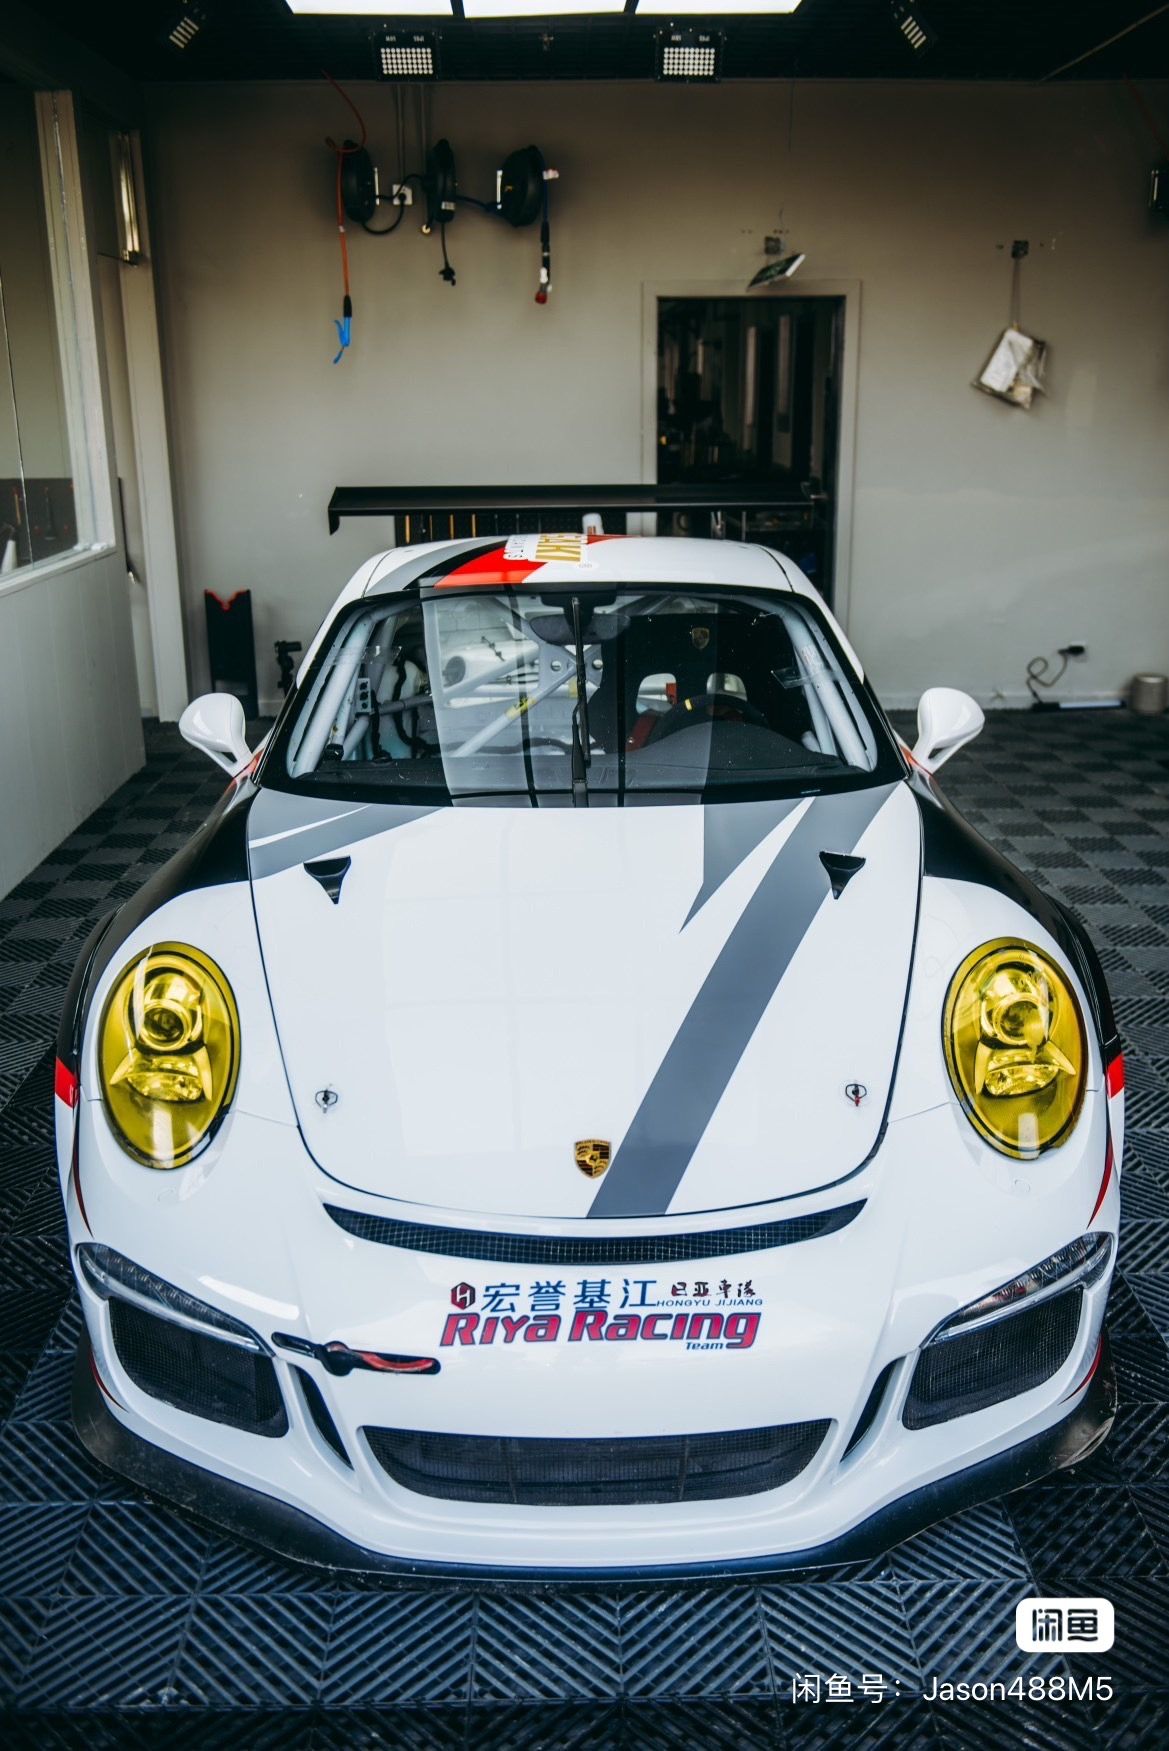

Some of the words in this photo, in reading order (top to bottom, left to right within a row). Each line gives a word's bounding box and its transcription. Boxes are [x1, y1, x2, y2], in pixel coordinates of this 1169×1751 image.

[481, 1278, 657, 1313] 宏誉基江
[656, 1299, 710, 1307] HONGYU
[715, 1298, 763, 1306] JIJIANG
[568, 1309, 761, 1349] Racing
[686, 1342, 724, 1350] Team
